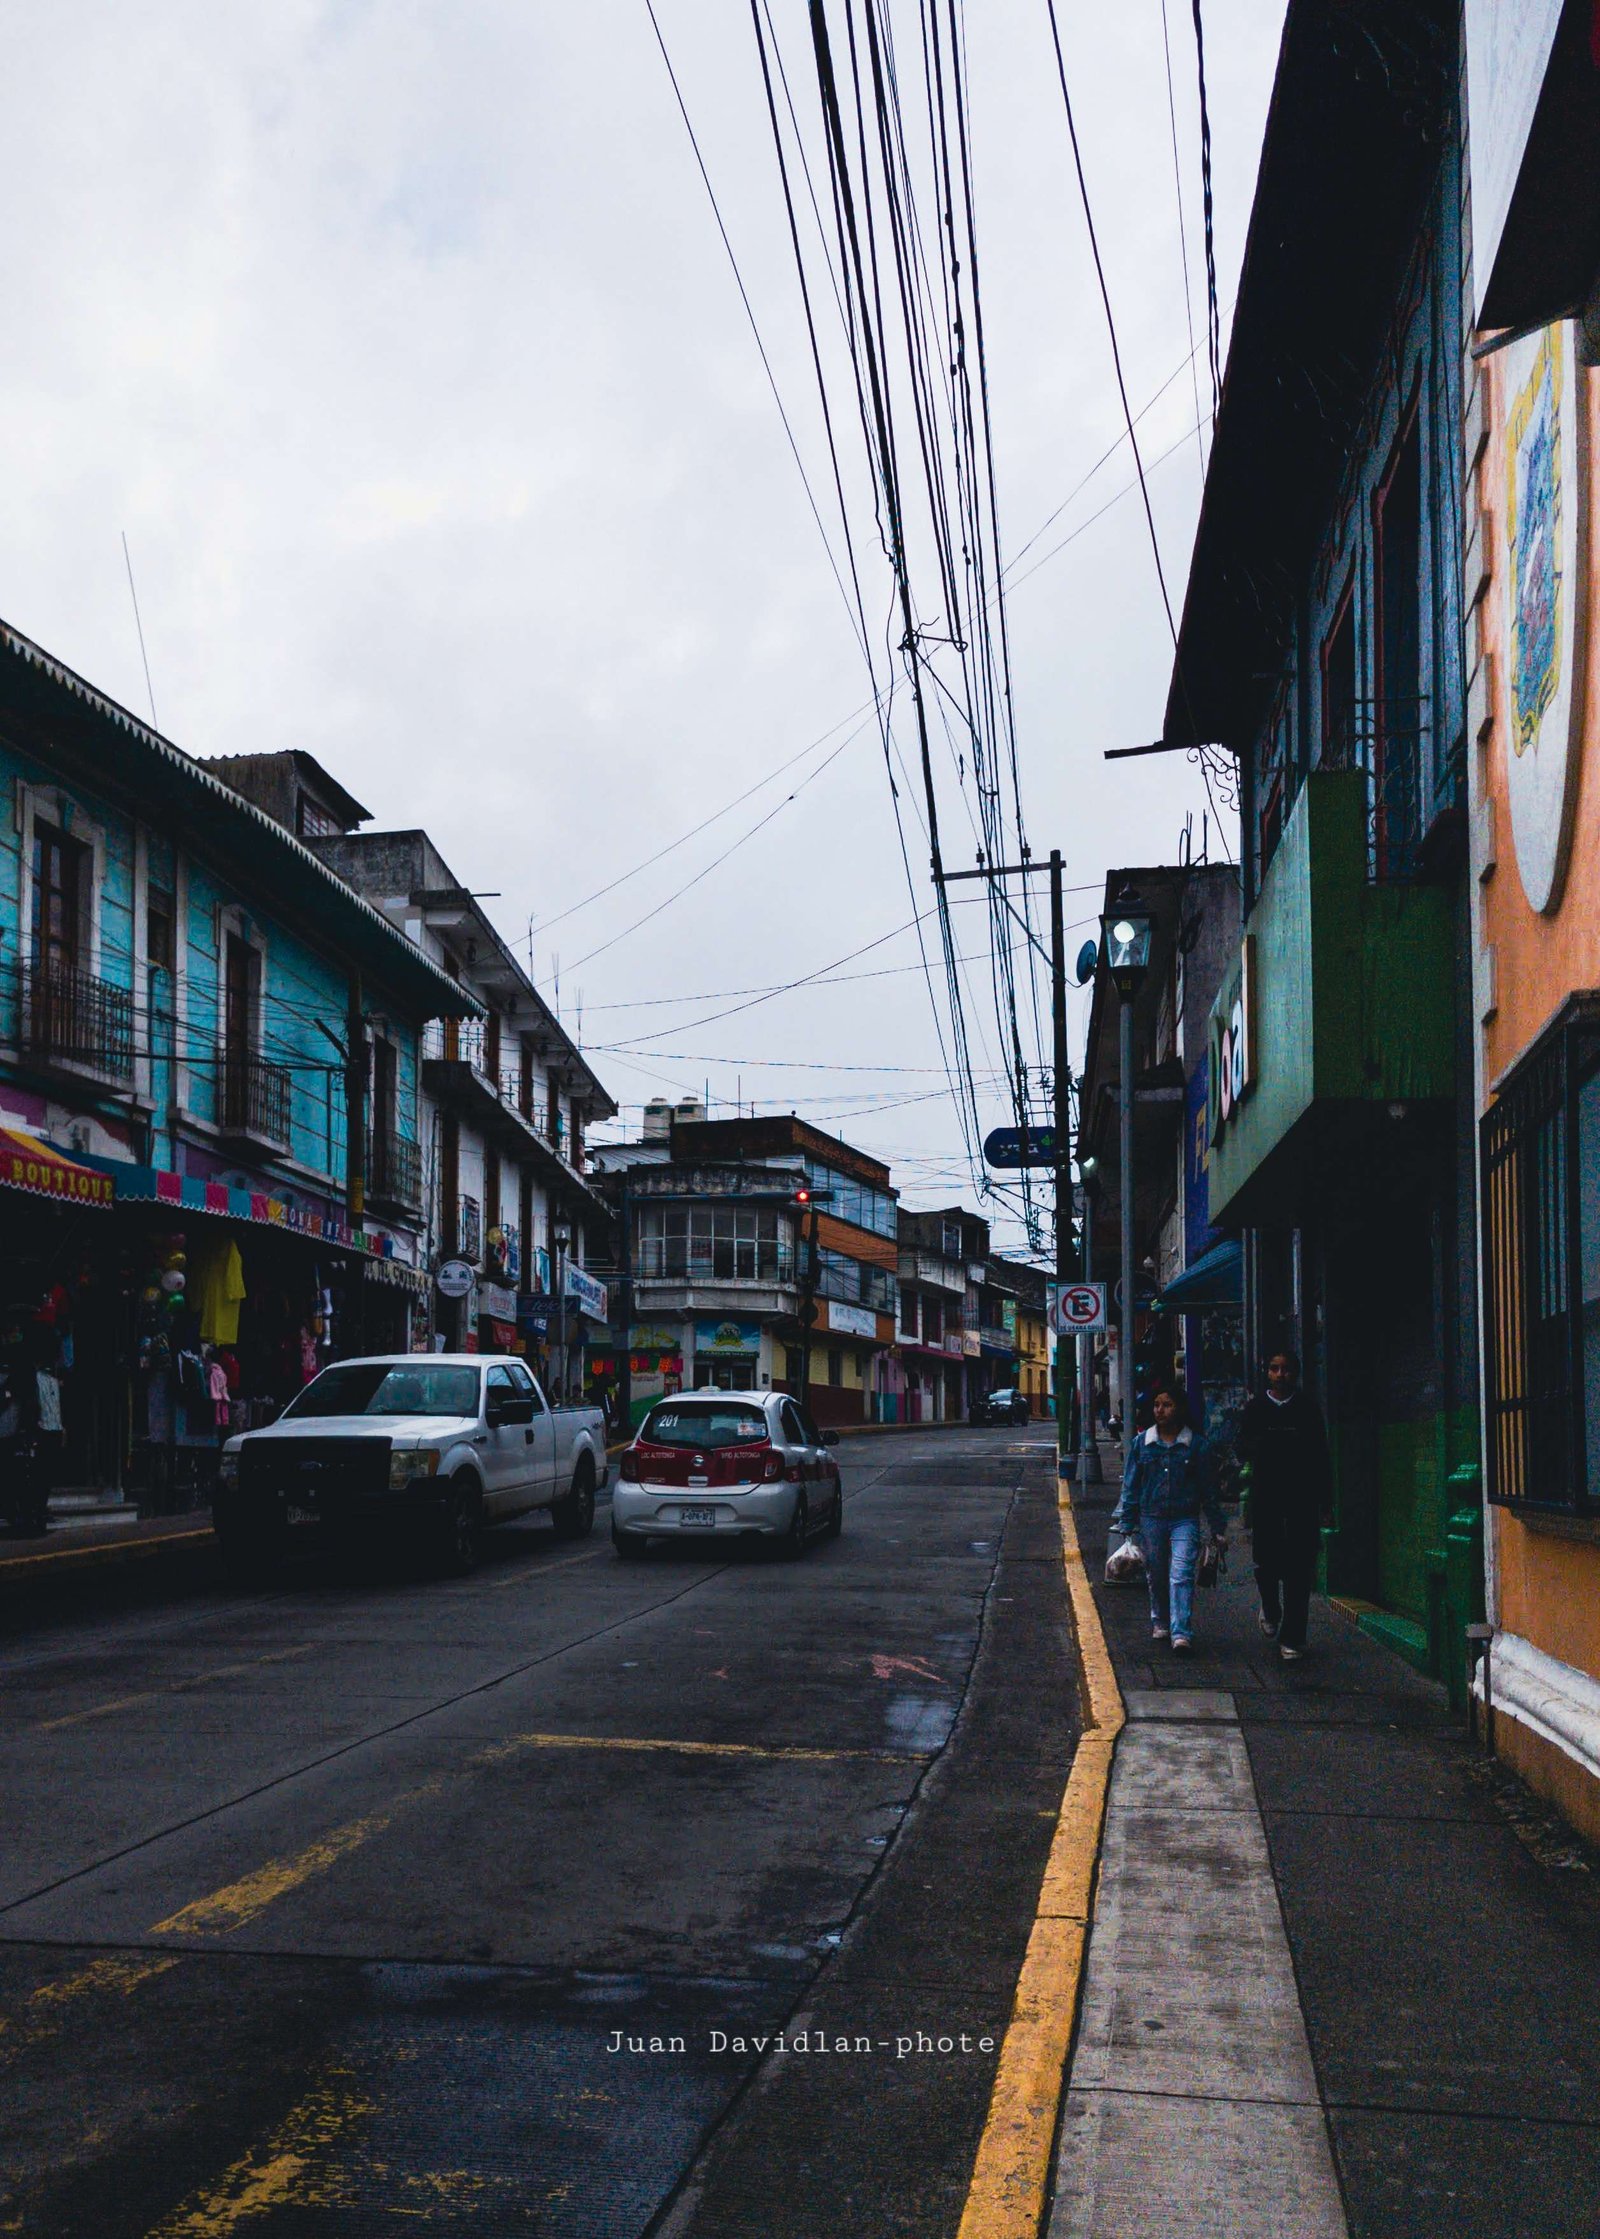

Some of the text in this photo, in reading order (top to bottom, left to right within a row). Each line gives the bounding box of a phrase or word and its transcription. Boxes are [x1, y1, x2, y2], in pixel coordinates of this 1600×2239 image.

[11, 1160, 113, 1200] BOUTIQUE
[281, 1205, 313, 1230] ZONA
[659, 1414, 679, 1427] 201
